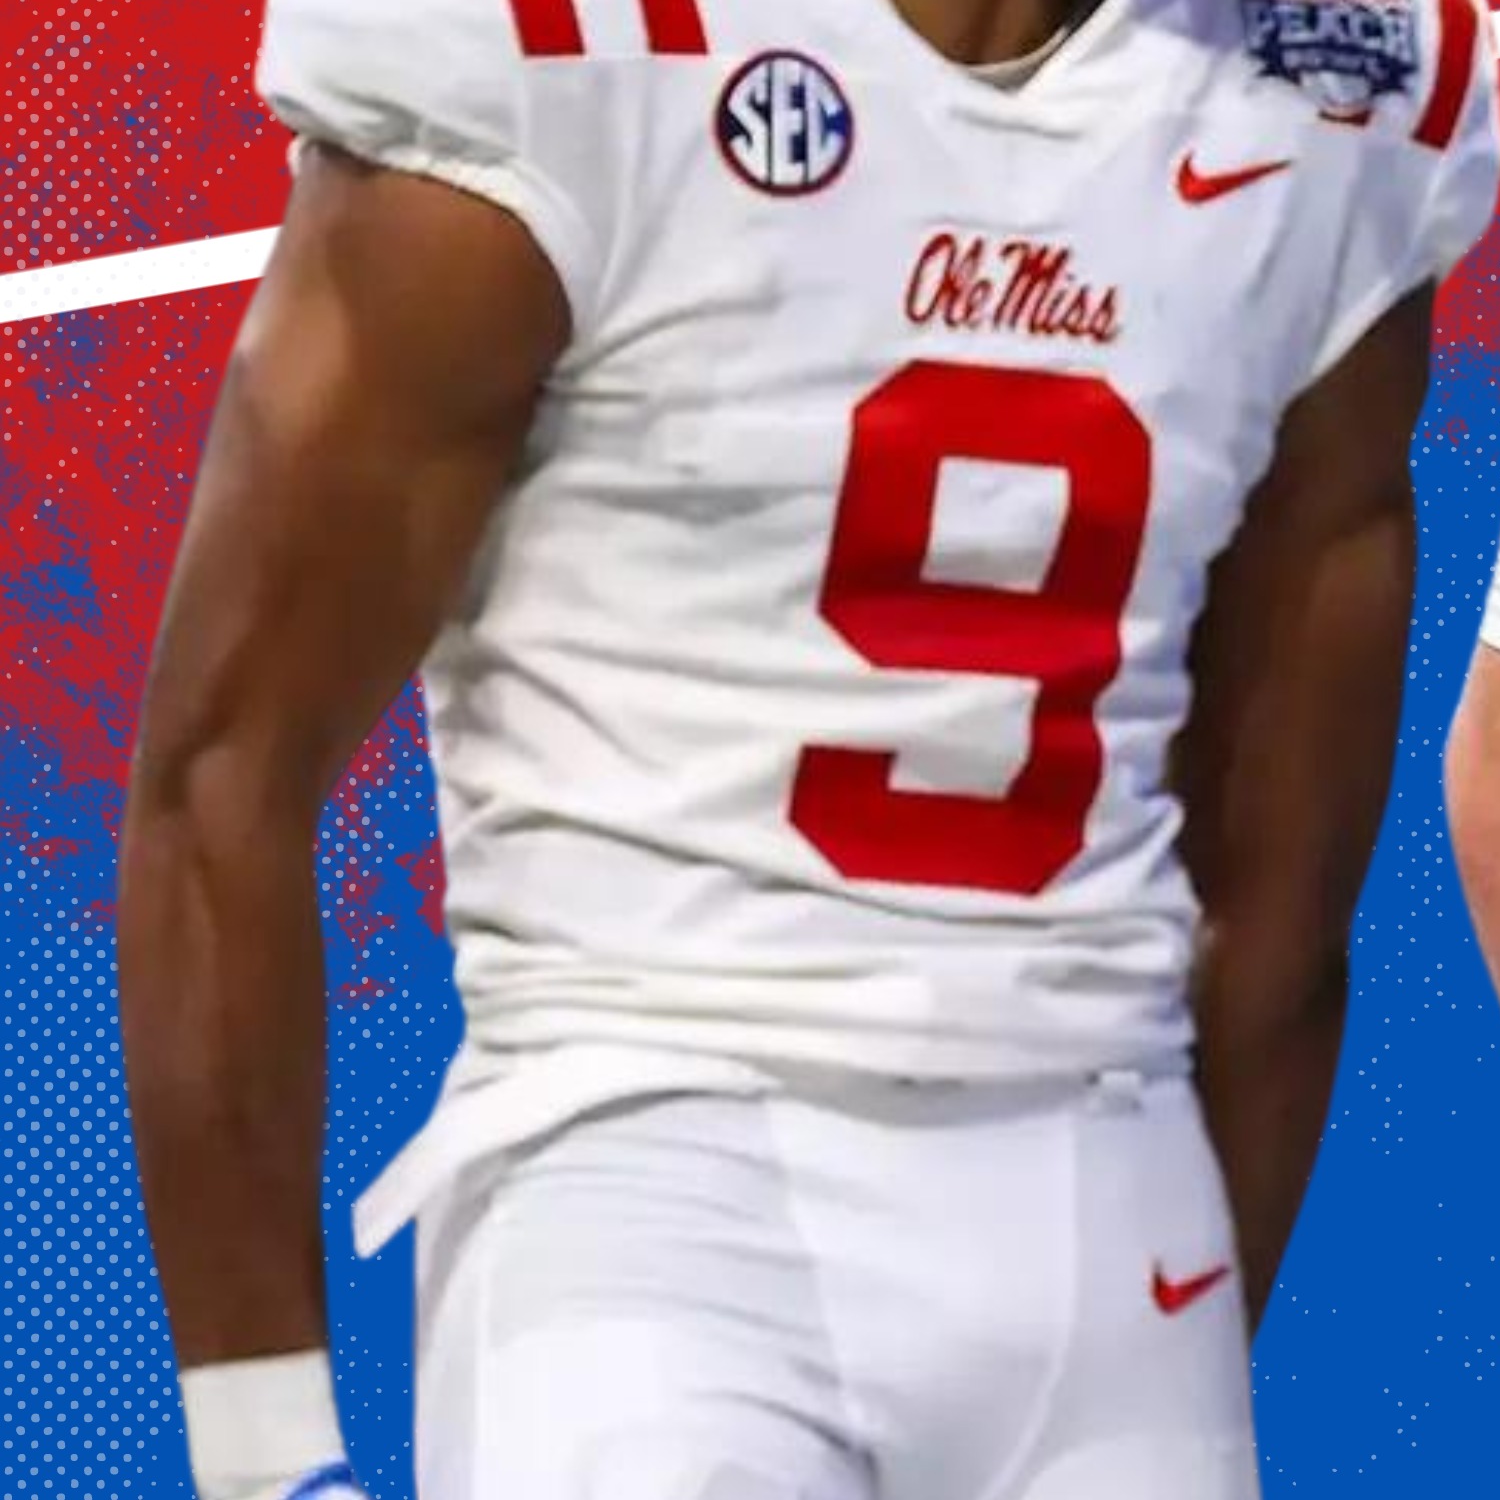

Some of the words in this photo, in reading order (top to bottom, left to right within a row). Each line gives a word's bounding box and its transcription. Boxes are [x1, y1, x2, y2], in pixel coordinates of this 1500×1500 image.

[727, 57, 848, 187] SEC
[905, 232, 994, 329] Ole
[992, 241, 1122, 344] Miss
[788, 358, 1153, 897] 9
